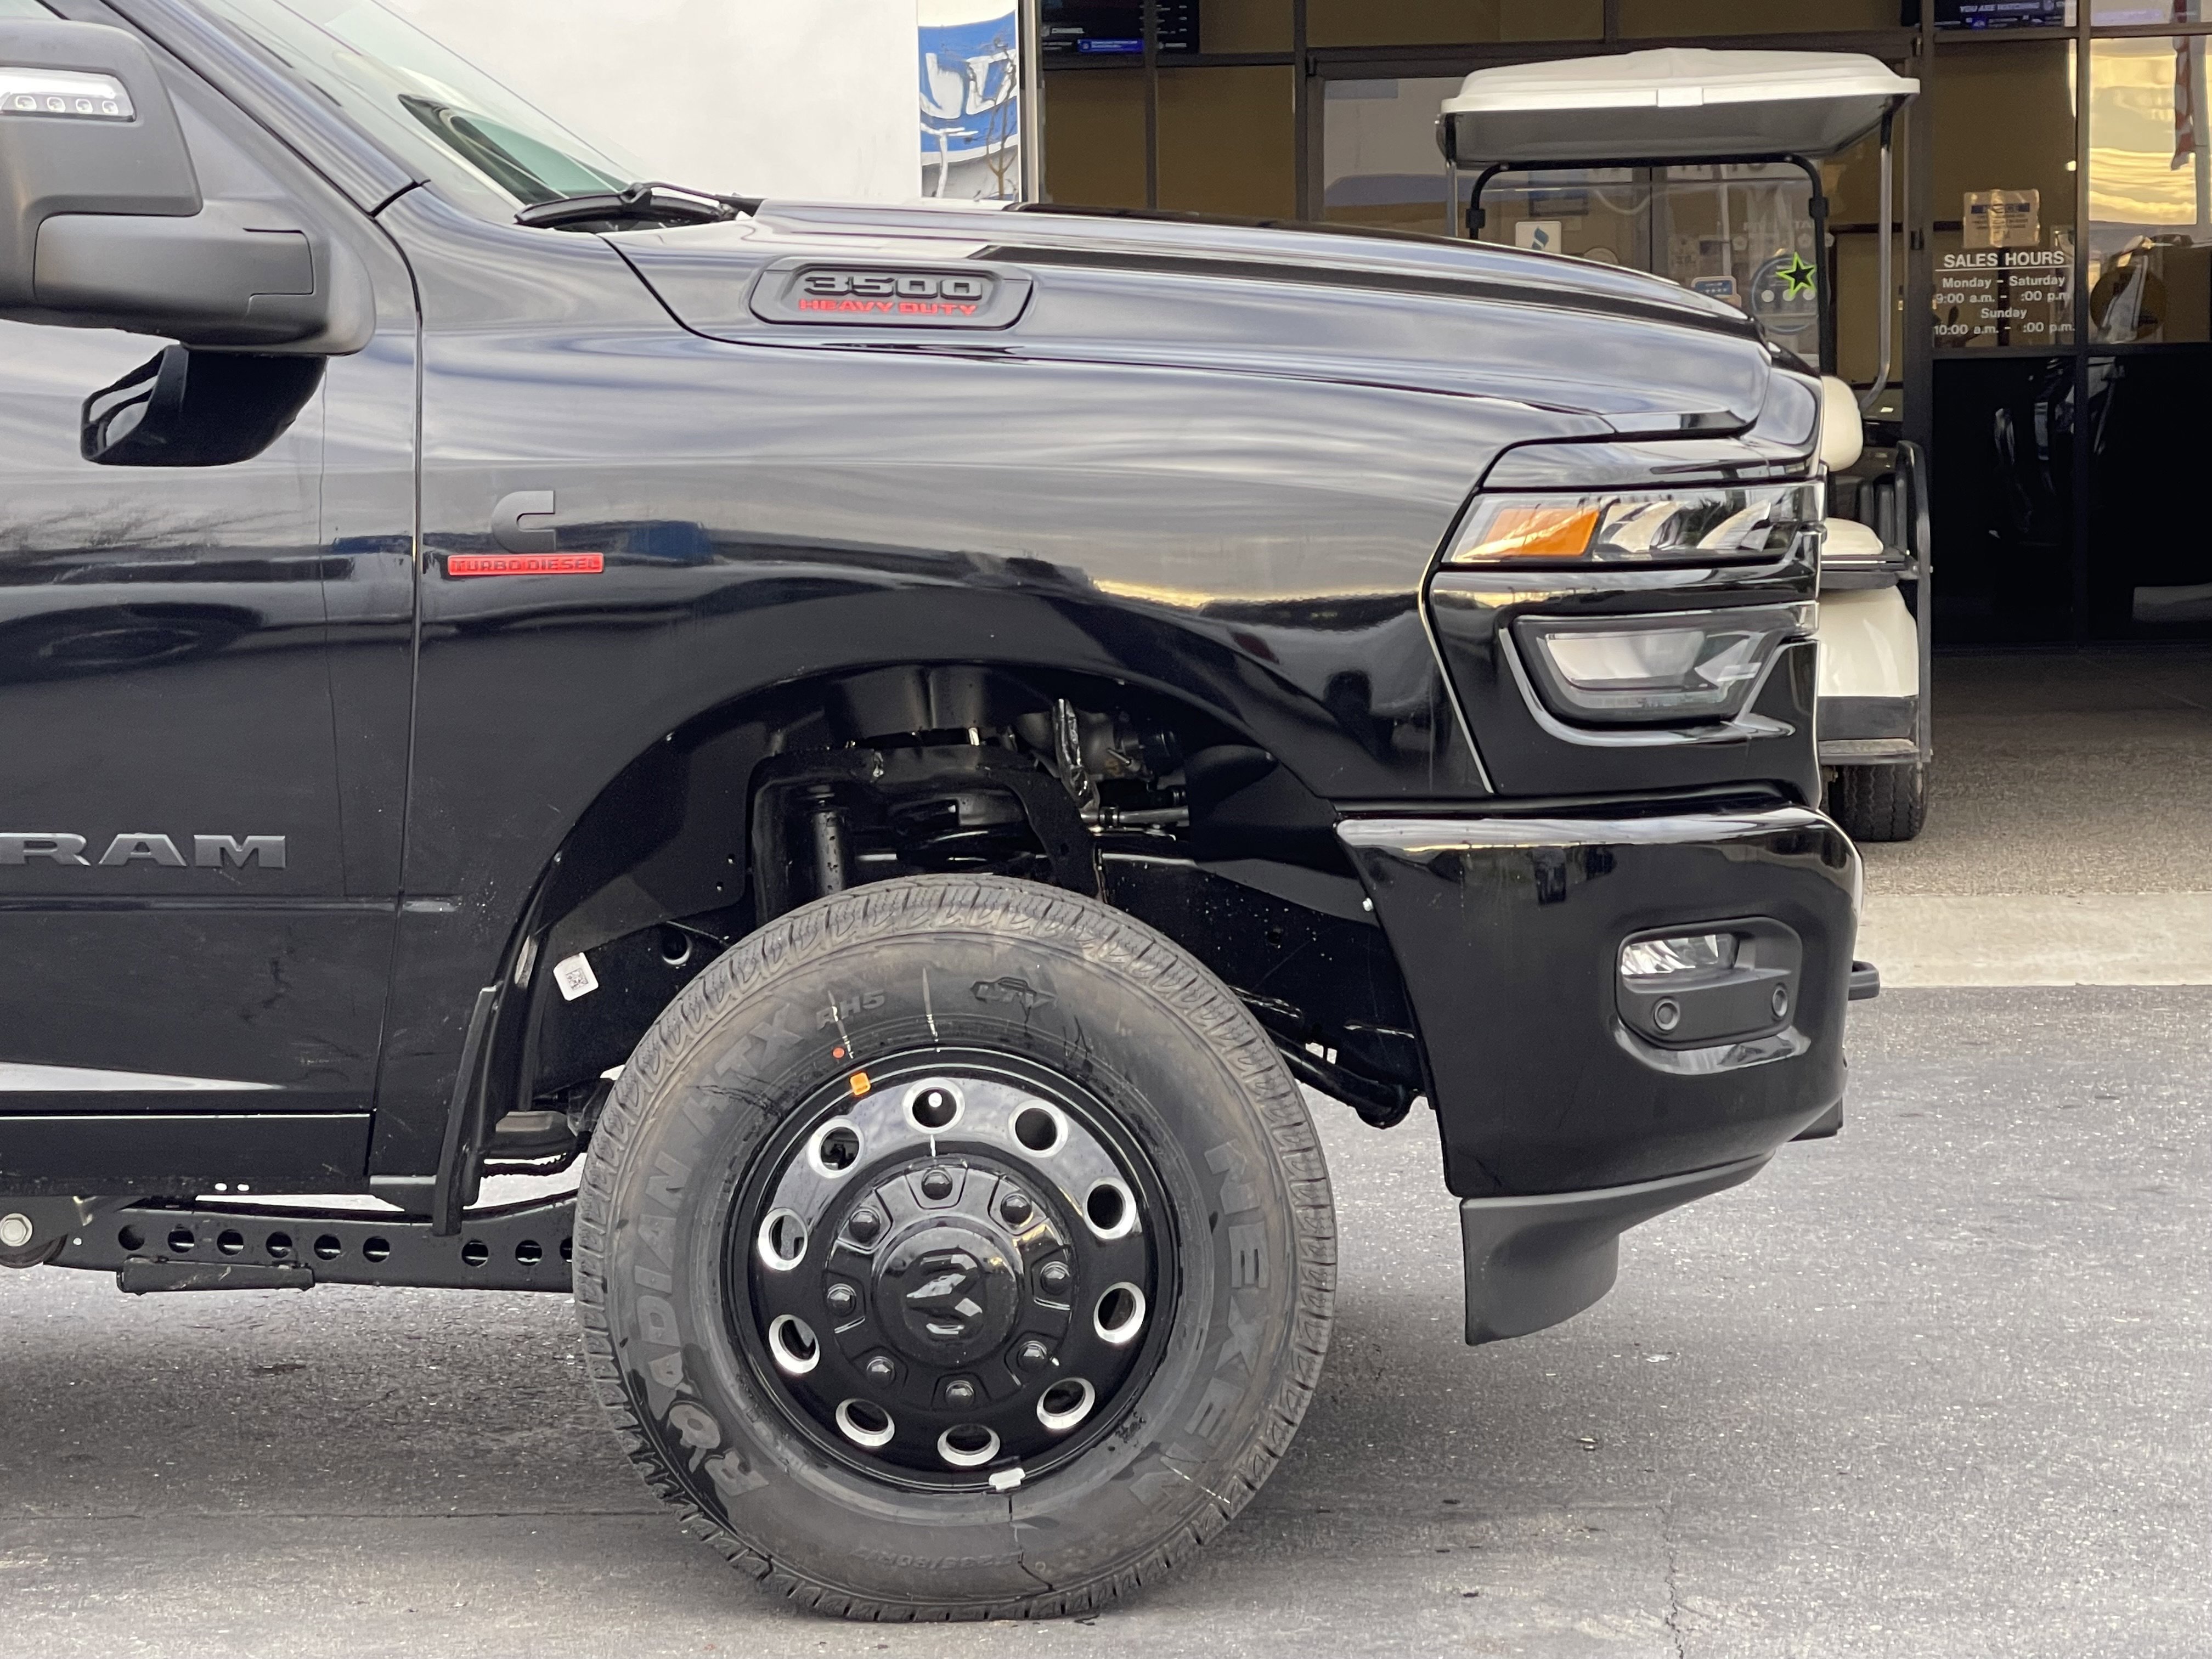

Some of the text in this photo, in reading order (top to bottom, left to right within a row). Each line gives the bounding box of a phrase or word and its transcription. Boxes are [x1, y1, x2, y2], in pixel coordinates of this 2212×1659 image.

[1944, 251, 2064, 268] SALES HOURS
[804, 275, 982, 301] 3500
[1943, 277, 1992, 289] Monday
[2009, 275, 2066, 287] Saturday
[1936, 293, 1965, 304] 9:00
[1970, 294, 1995, 303] a.m.
[799, 298, 977, 317] HEAVY DUTY
[1981, 307, 2028, 319] Sunday
[1934, 324, 1968, 335] 10:00
[1973, 325, 1999, 334] a.m.
[2049, 323, 2075, 335] p.m.
[452, 557, 600, 572] TURBO DIESEL
[0, 832, 287, 869] RAM
[635, 1150, 769, 1497] ROADIAN
[816, 989, 886, 1030] RH5
[1130, 1138, 1268, 1510] NEXEN
